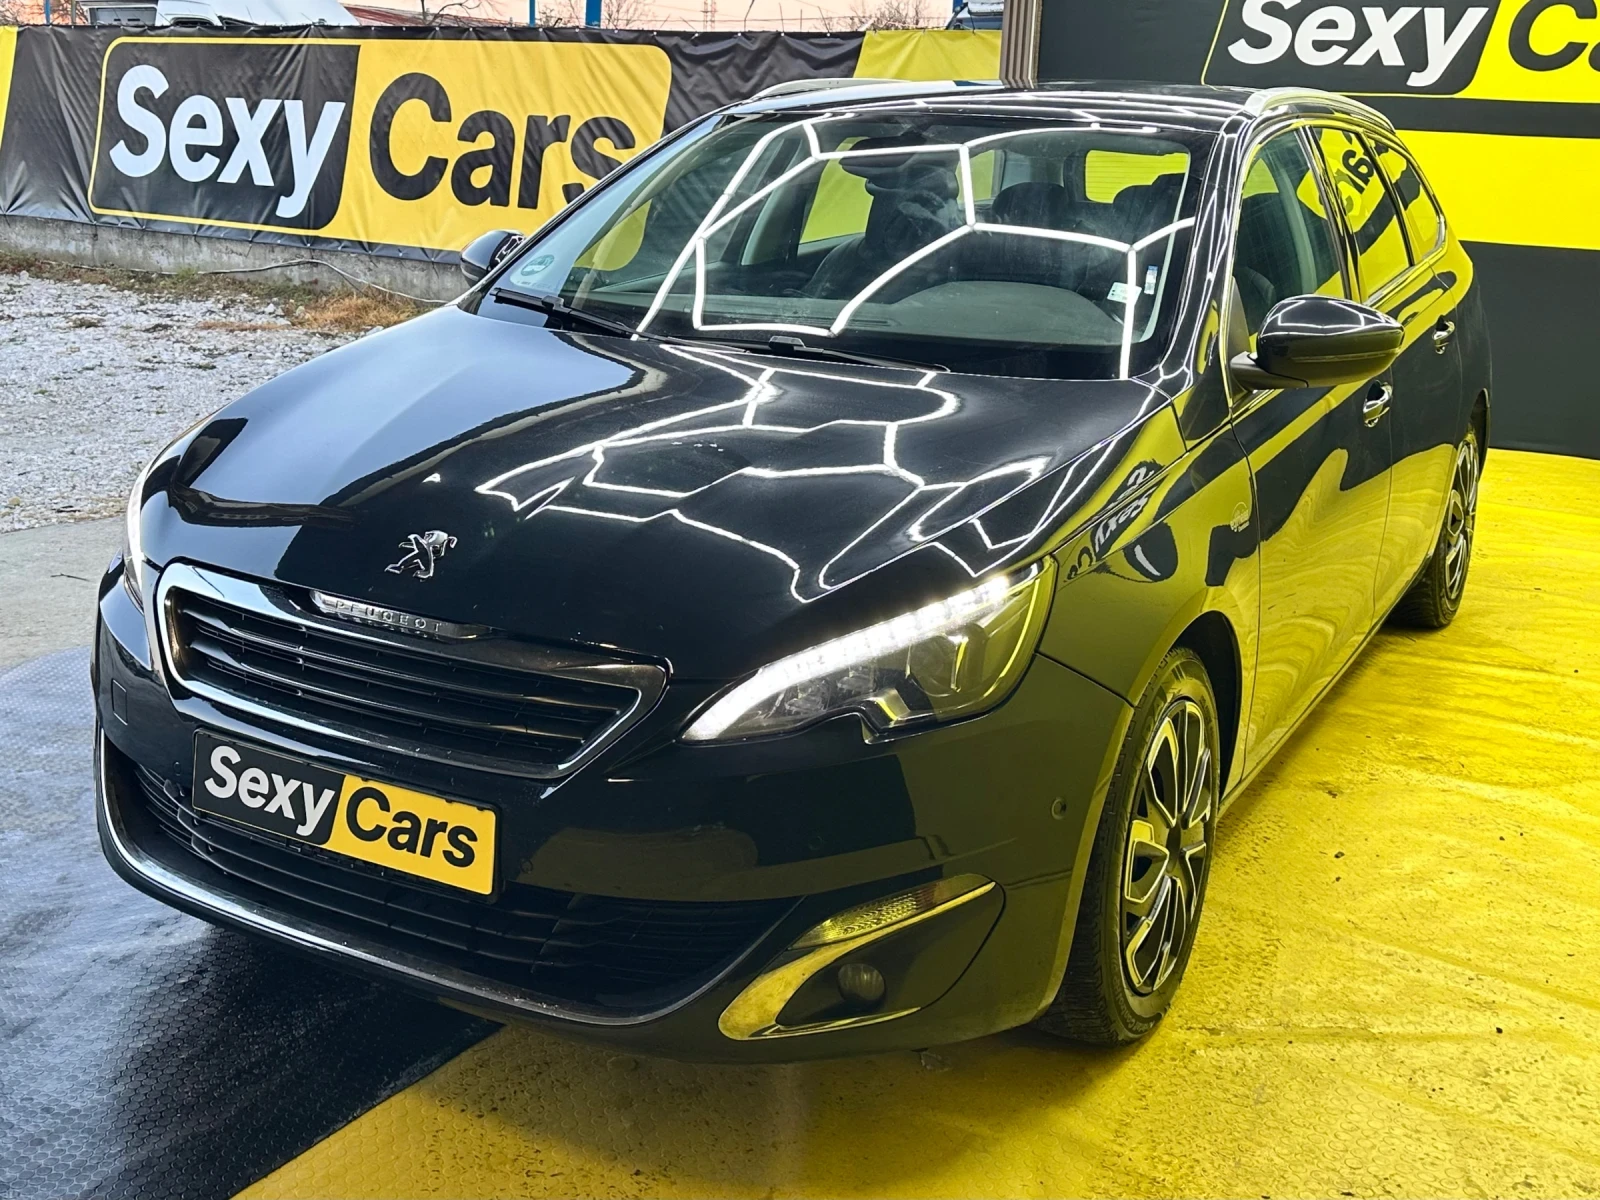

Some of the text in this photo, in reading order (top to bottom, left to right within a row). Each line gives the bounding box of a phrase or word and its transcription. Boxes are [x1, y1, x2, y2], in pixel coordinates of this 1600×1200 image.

[1228, 0, 1600, 87] Sexy C
[109, 64, 637, 219] Sexy Cars
[335, 600, 442, 632] PEUGEOT
[204, 746, 478, 868] Sexy Cars
